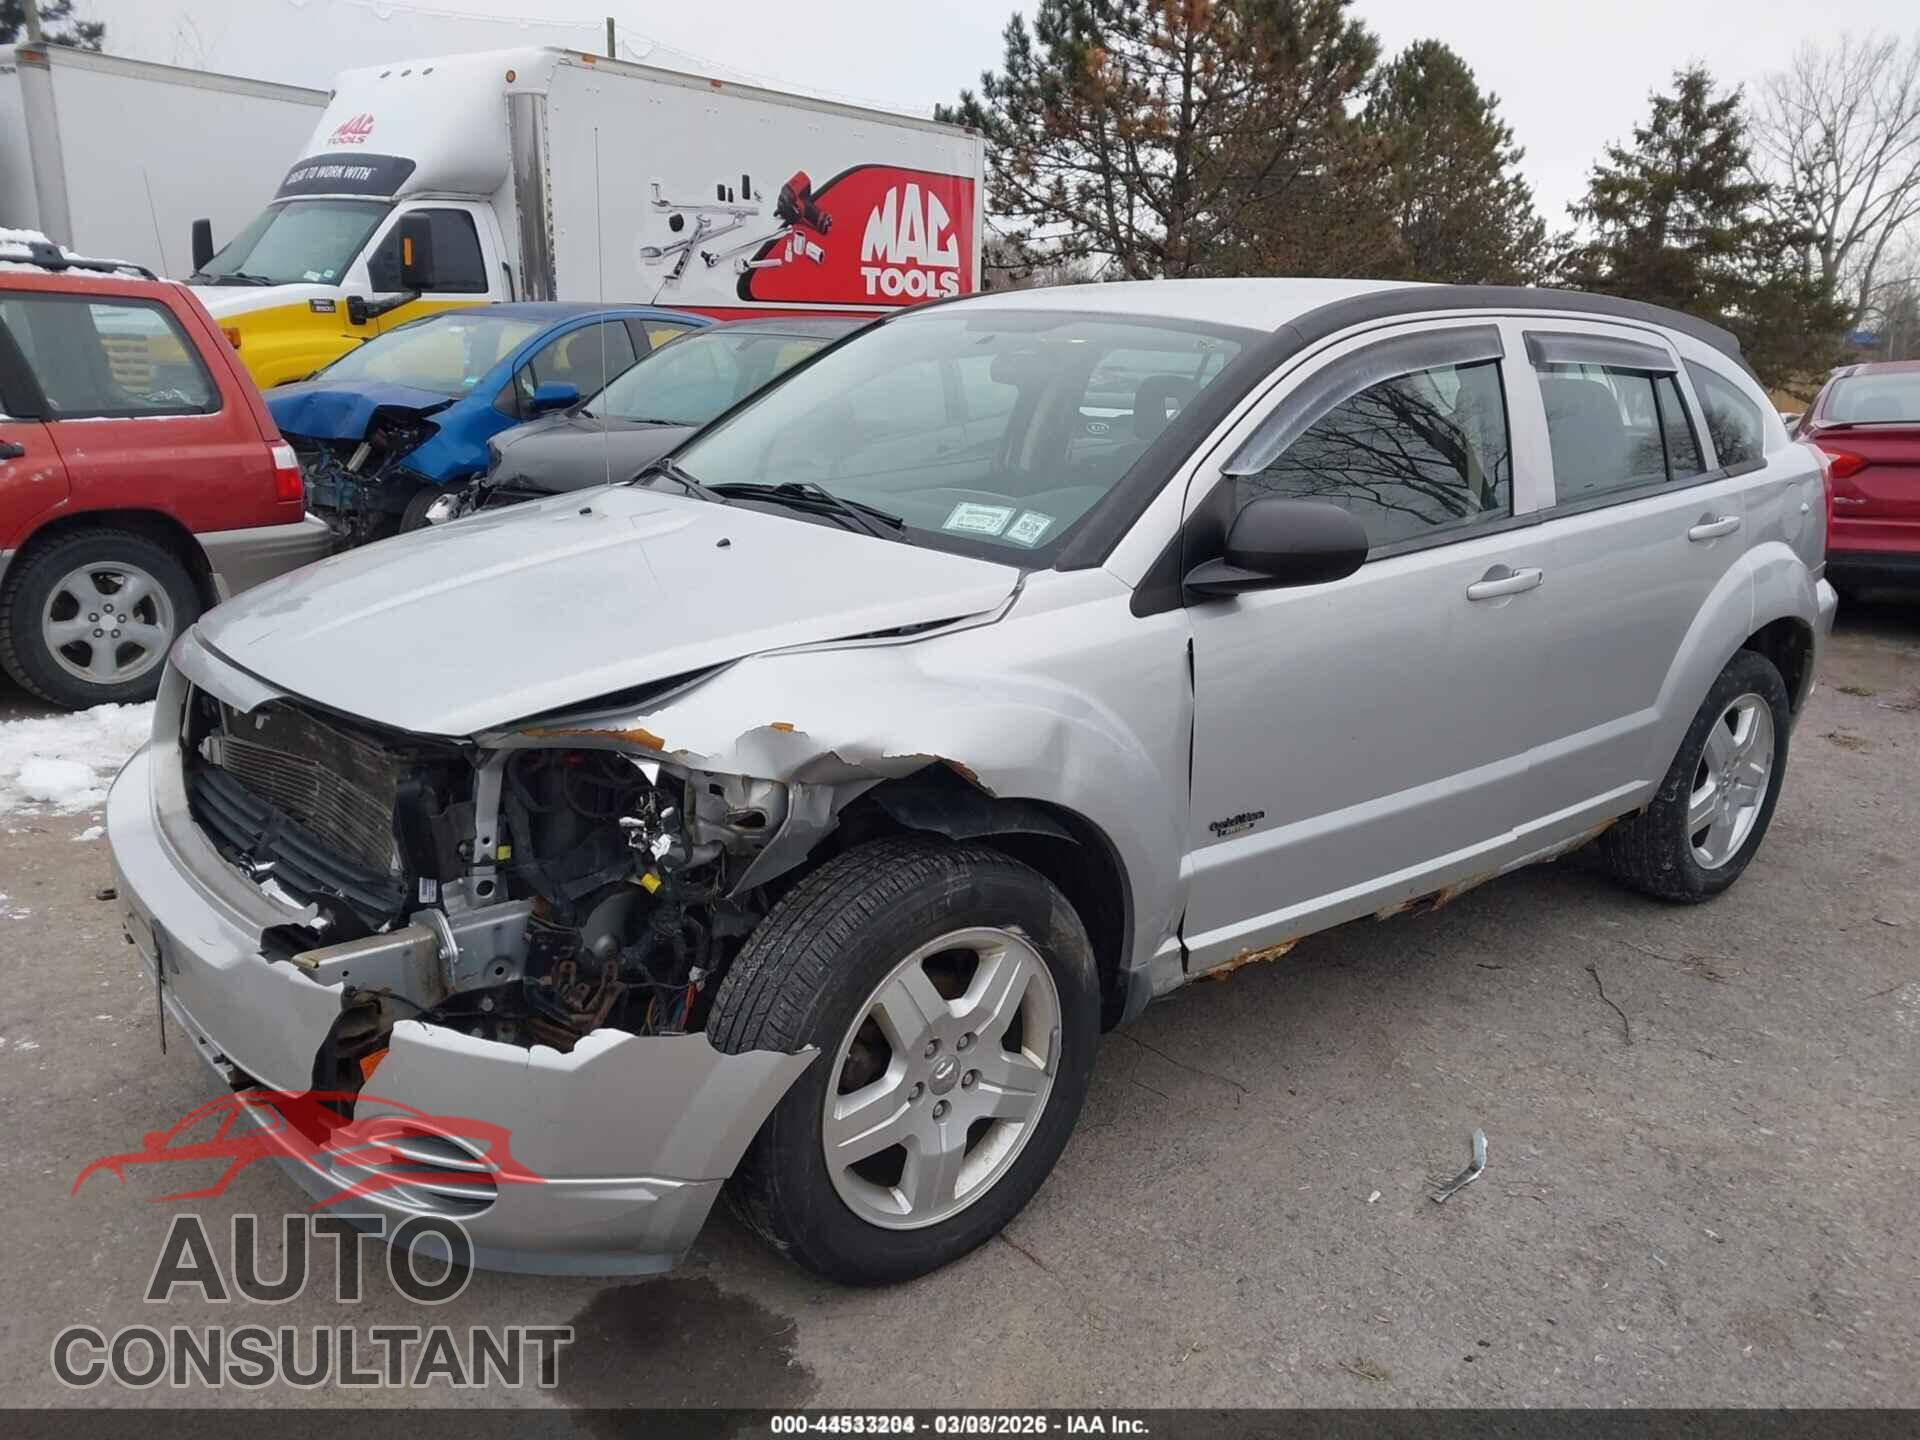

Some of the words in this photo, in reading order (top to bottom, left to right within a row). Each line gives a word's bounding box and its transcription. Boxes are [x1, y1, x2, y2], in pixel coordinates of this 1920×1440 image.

[331, 112, 375, 136] MAC
[328, 135, 366, 145] TOOLS
[316, 165, 345, 179] WORK
[861, 183, 960, 268] MAC
[861, 266, 960, 298] TOOLS
